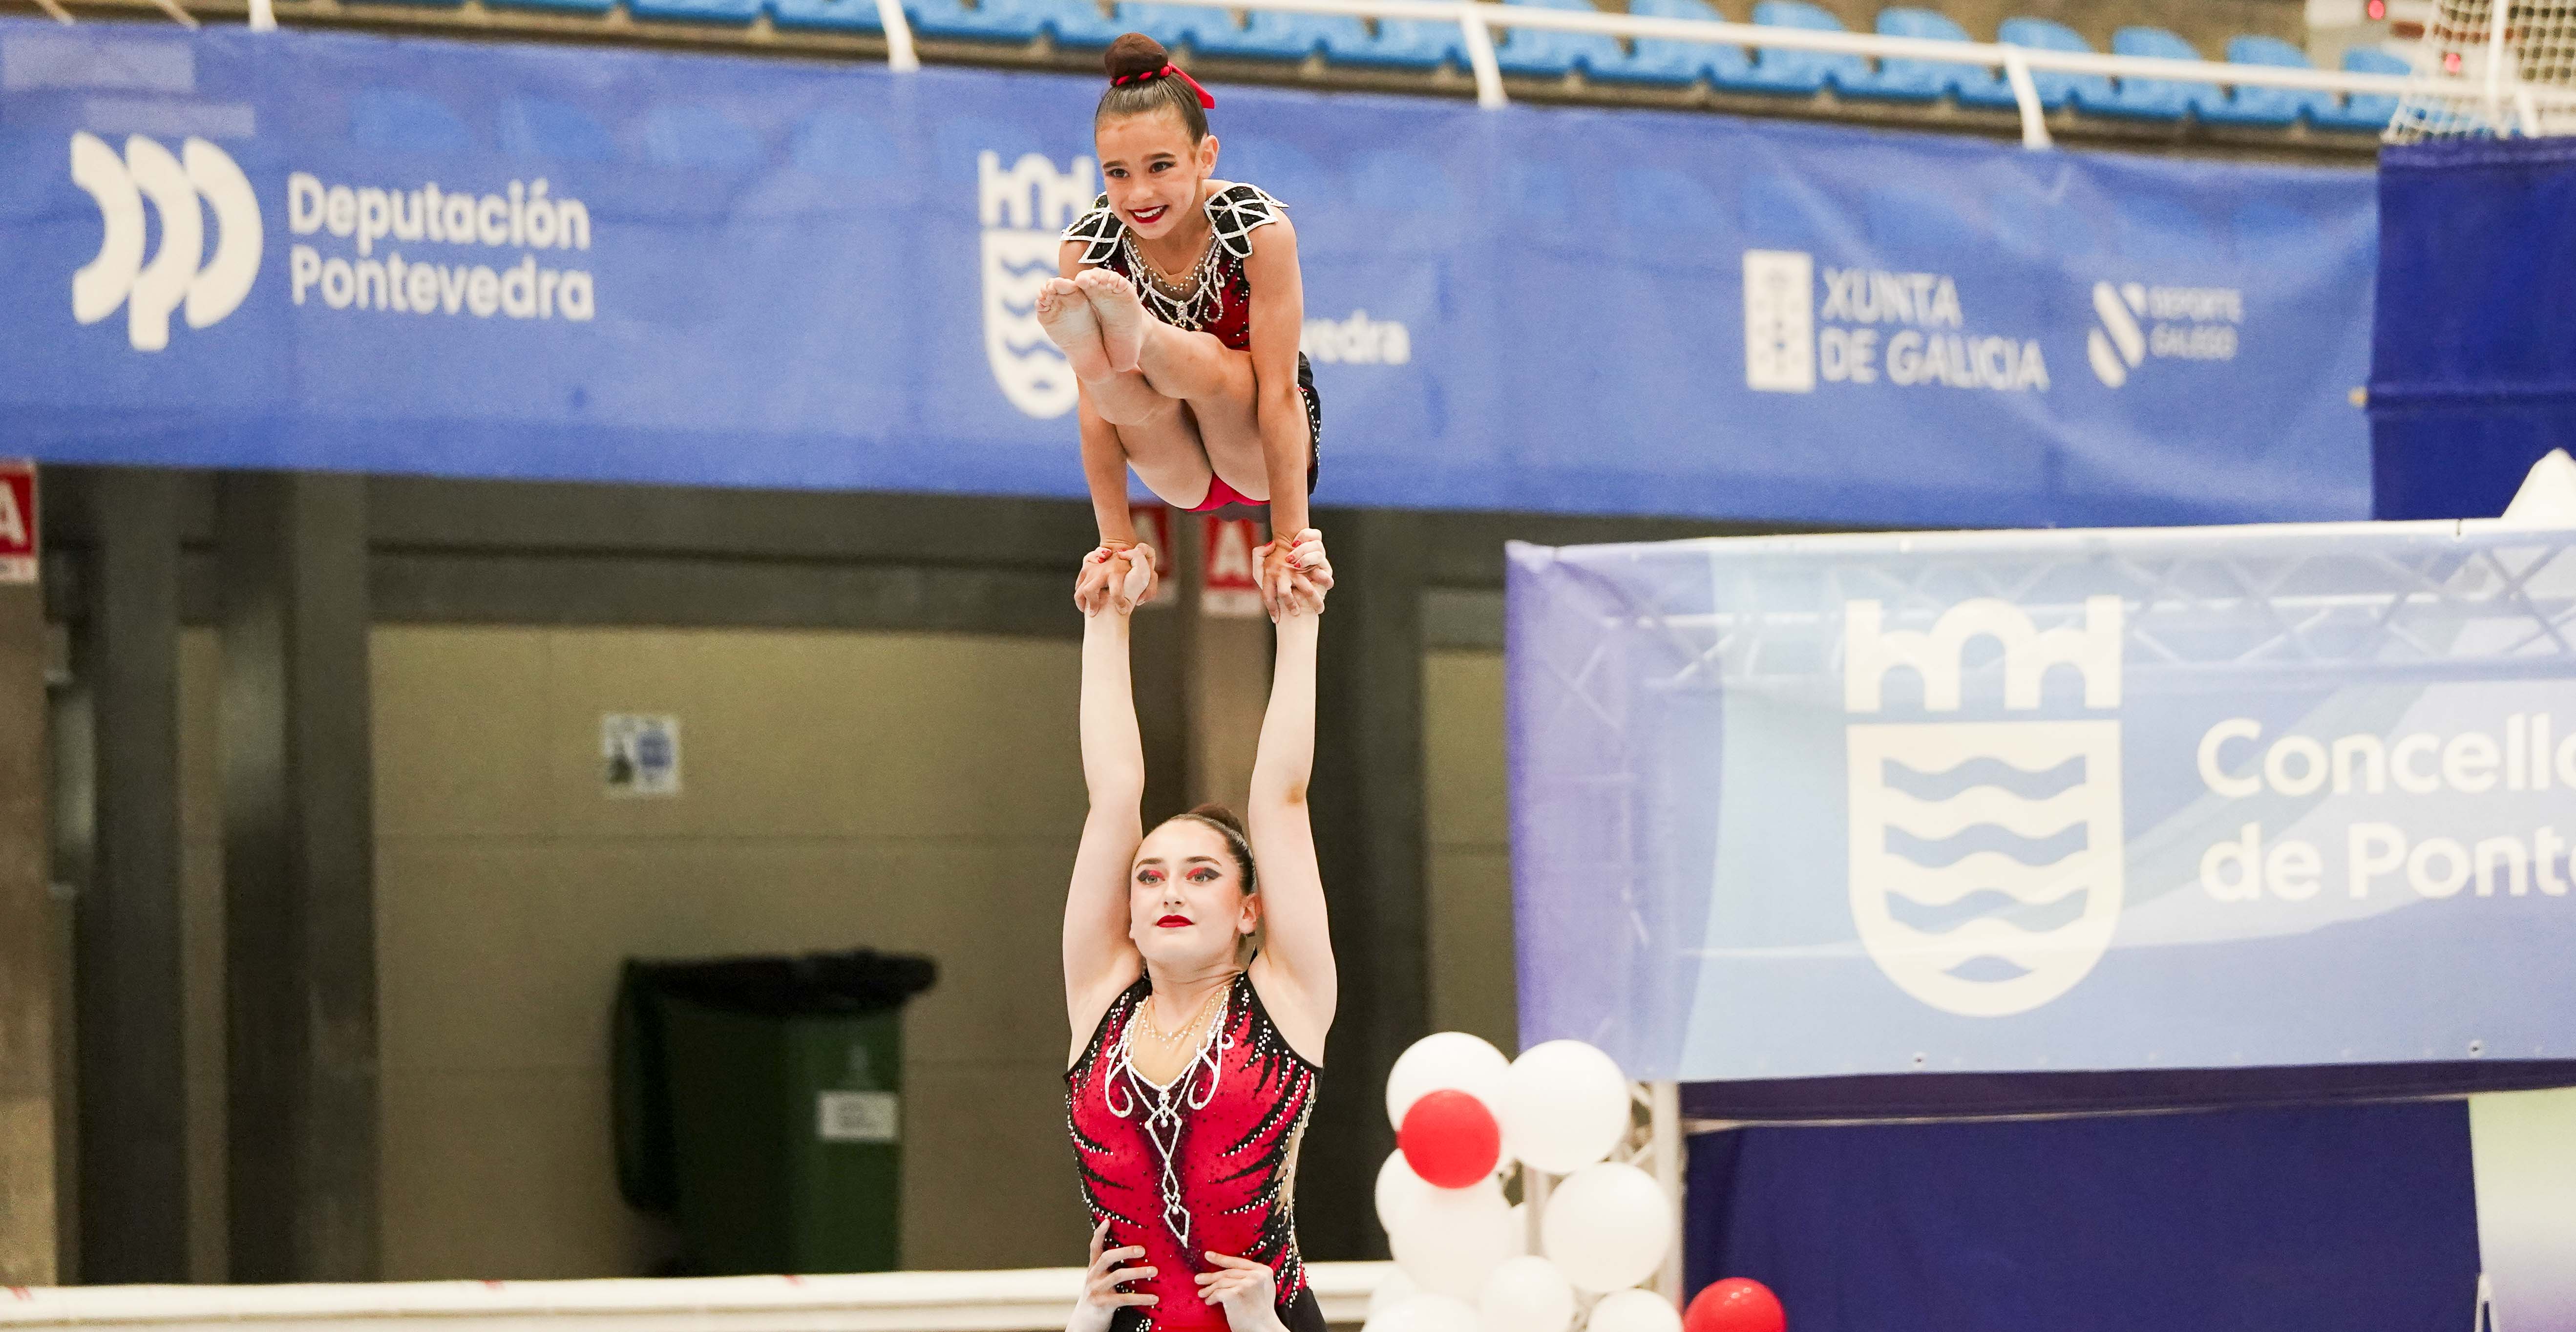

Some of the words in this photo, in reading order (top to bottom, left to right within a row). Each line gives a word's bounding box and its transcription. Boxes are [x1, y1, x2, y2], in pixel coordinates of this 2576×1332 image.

[288, 172, 590, 256] Deputación
[290, 245, 594, 320] Pontevedra
[1822, 268, 1962, 326] XUNTA
[1300, 310, 1411, 364] vedra
[1821, 327, 1877, 383] DE
[1886, 336, 2049, 390] GALICIA
[2199, 823, 2323, 902] de
[2349, 823, 2576, 898] Pont
